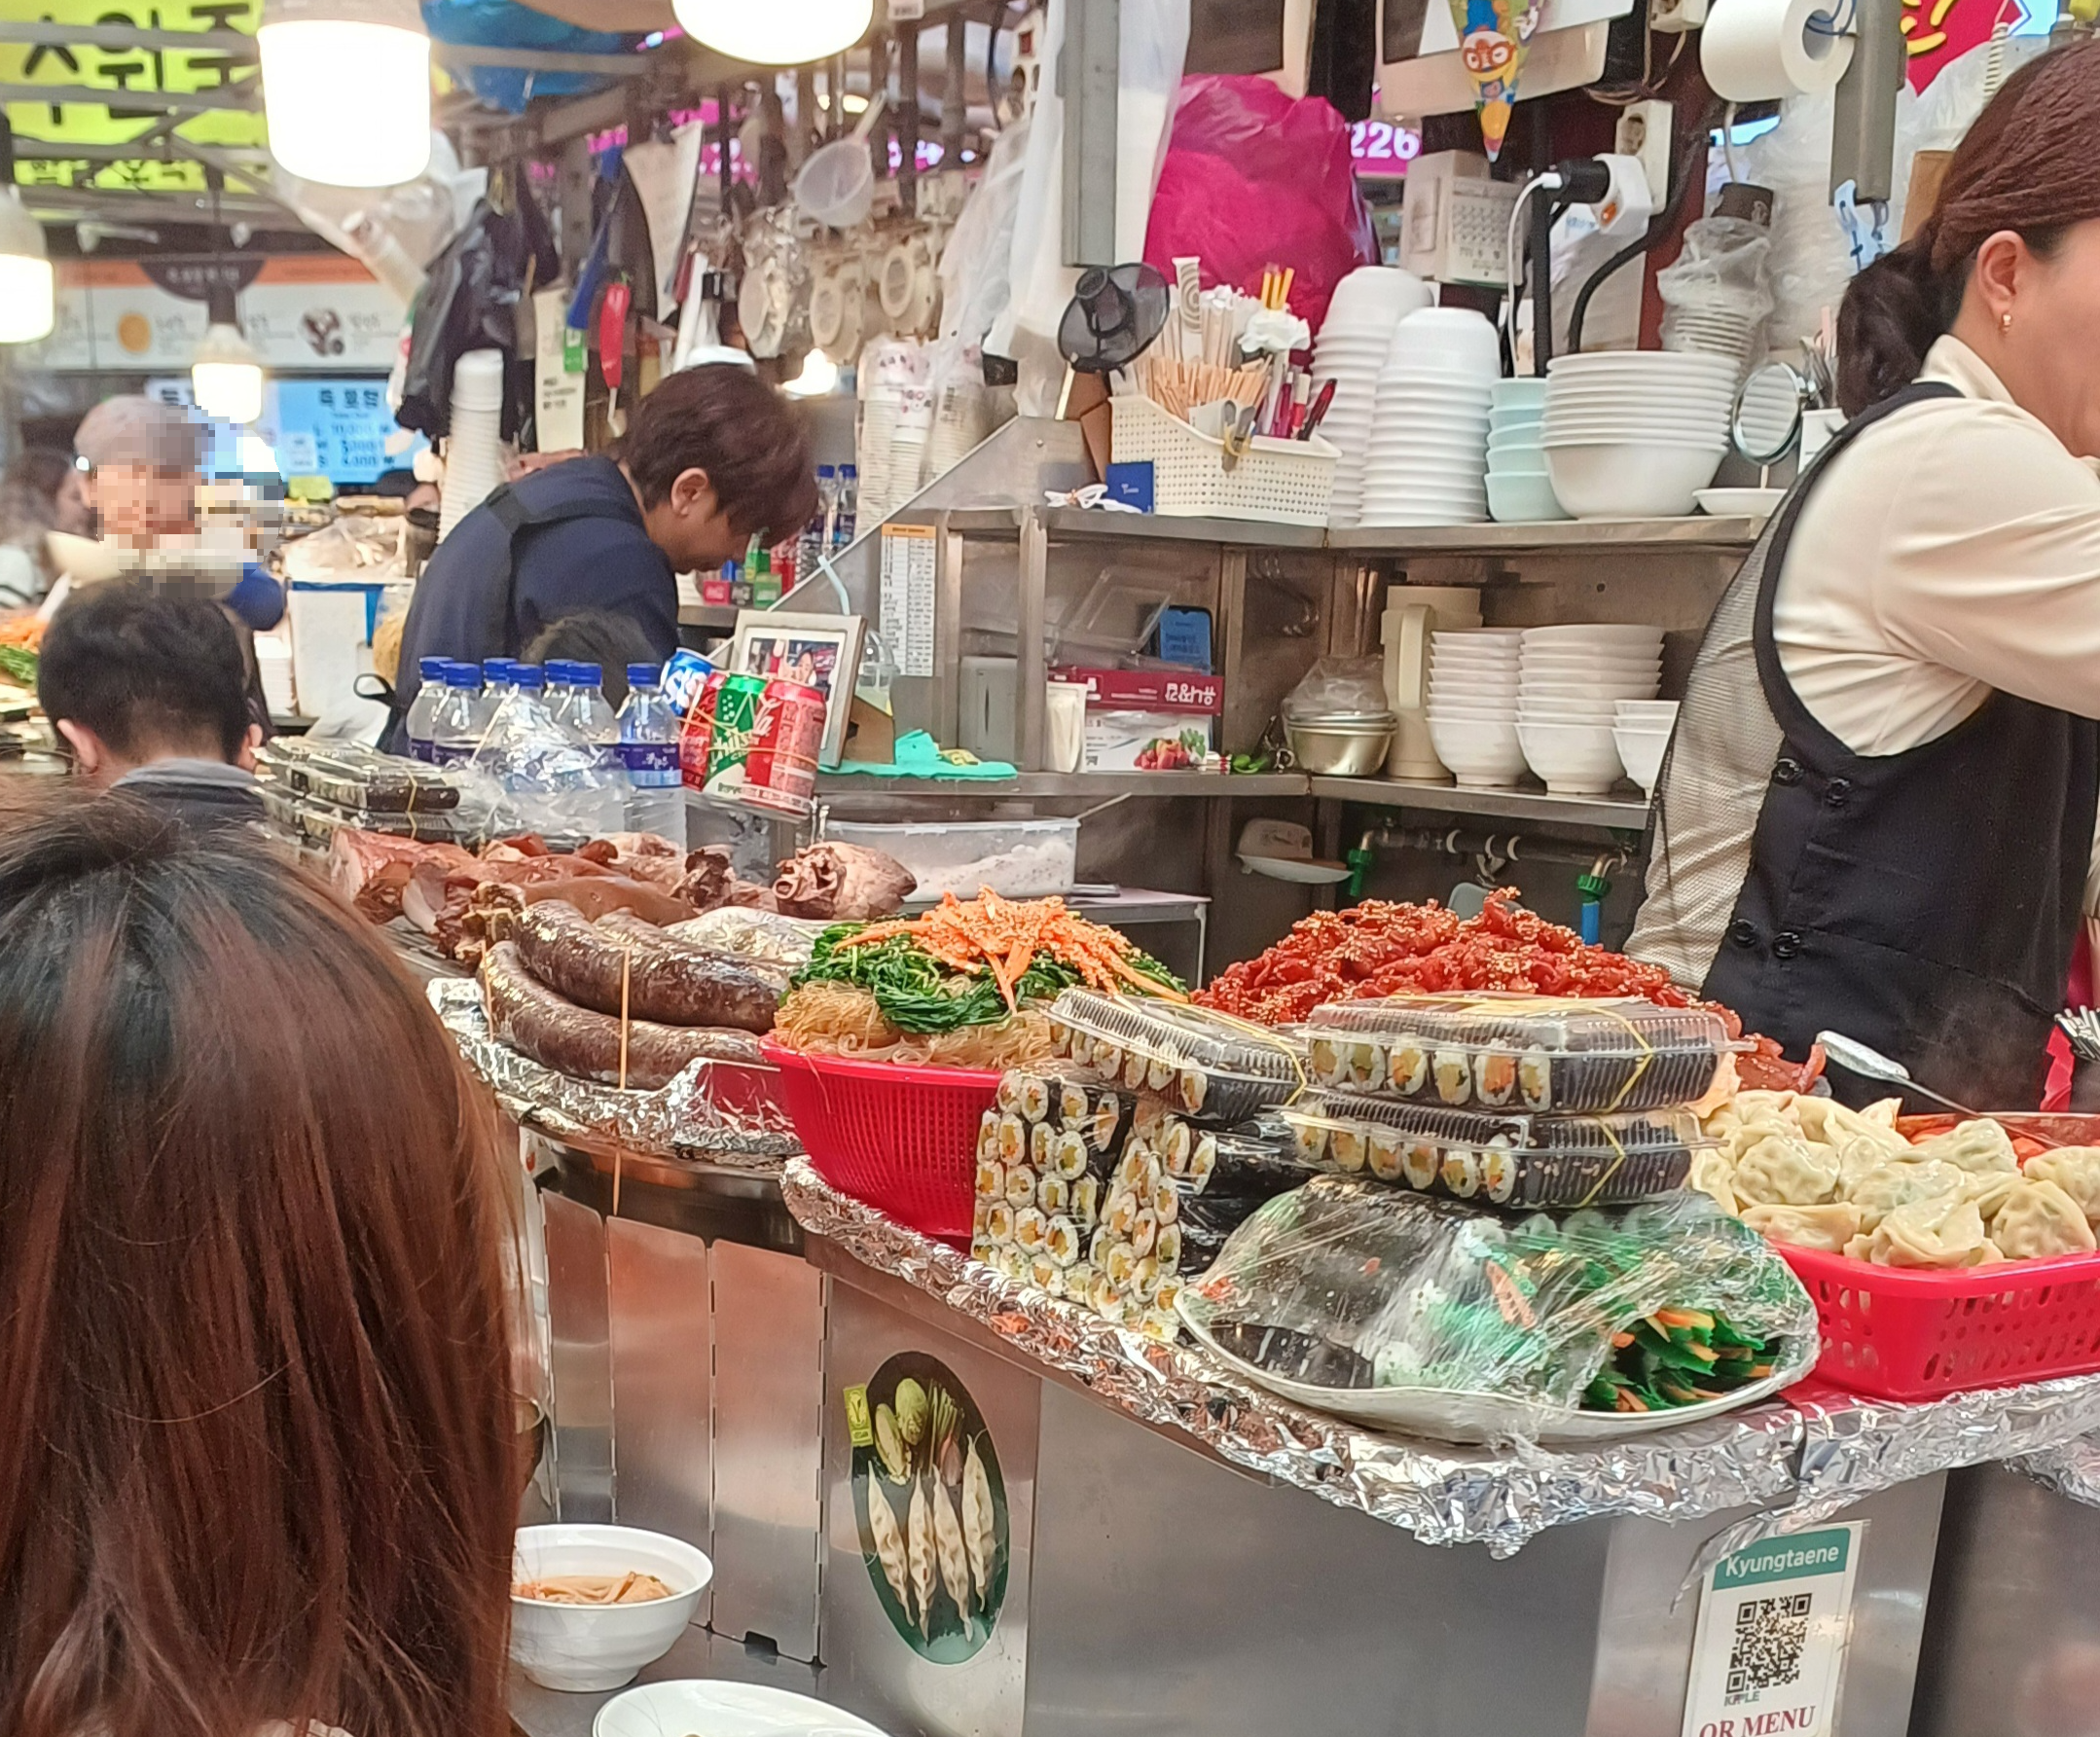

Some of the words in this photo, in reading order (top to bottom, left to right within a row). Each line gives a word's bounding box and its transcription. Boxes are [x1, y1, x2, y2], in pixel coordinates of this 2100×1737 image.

[1165, 682, 1216, 706] 유니장갑
[1725, 1545, 1839, 1576] Kyungtaene
[1741, 1706, 1816, 1737] MENU
